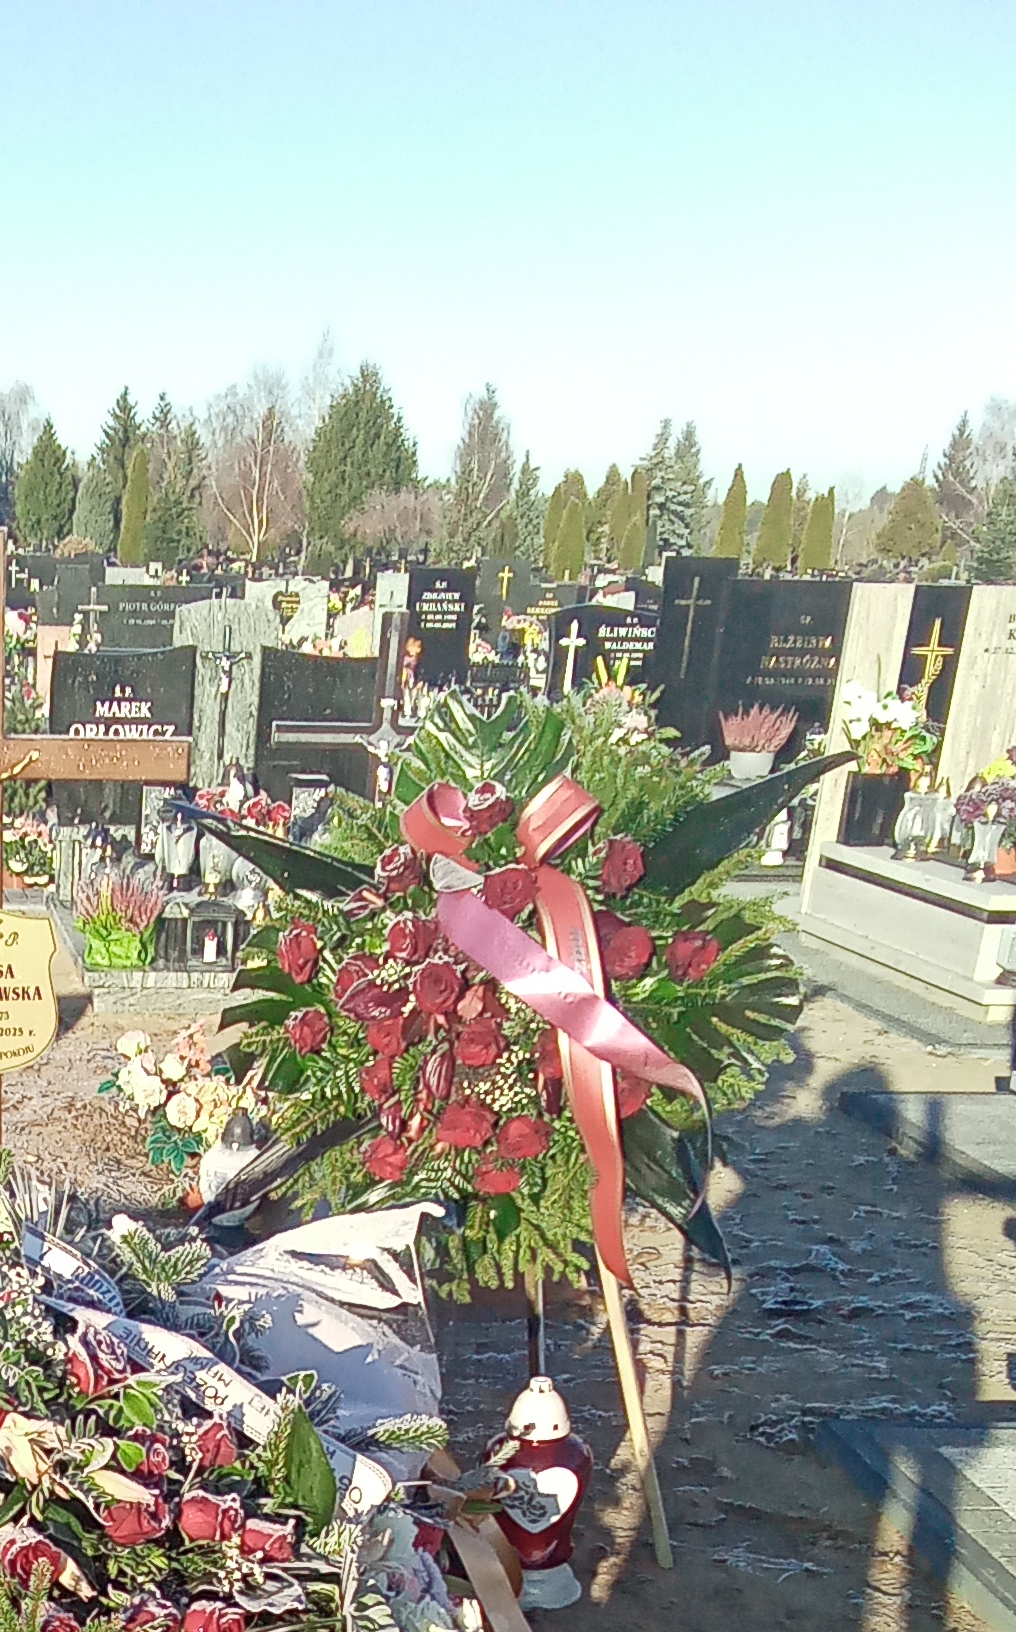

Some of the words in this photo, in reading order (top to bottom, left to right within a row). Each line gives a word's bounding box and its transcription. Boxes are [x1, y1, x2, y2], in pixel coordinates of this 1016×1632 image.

[95, 700, 152, 718] MAREK
[68, 724, 175, 738] ORŁOWICZ
[28, 1029, 36, 1038] r.
[0, 1044, 35, 1061] POKOJU
